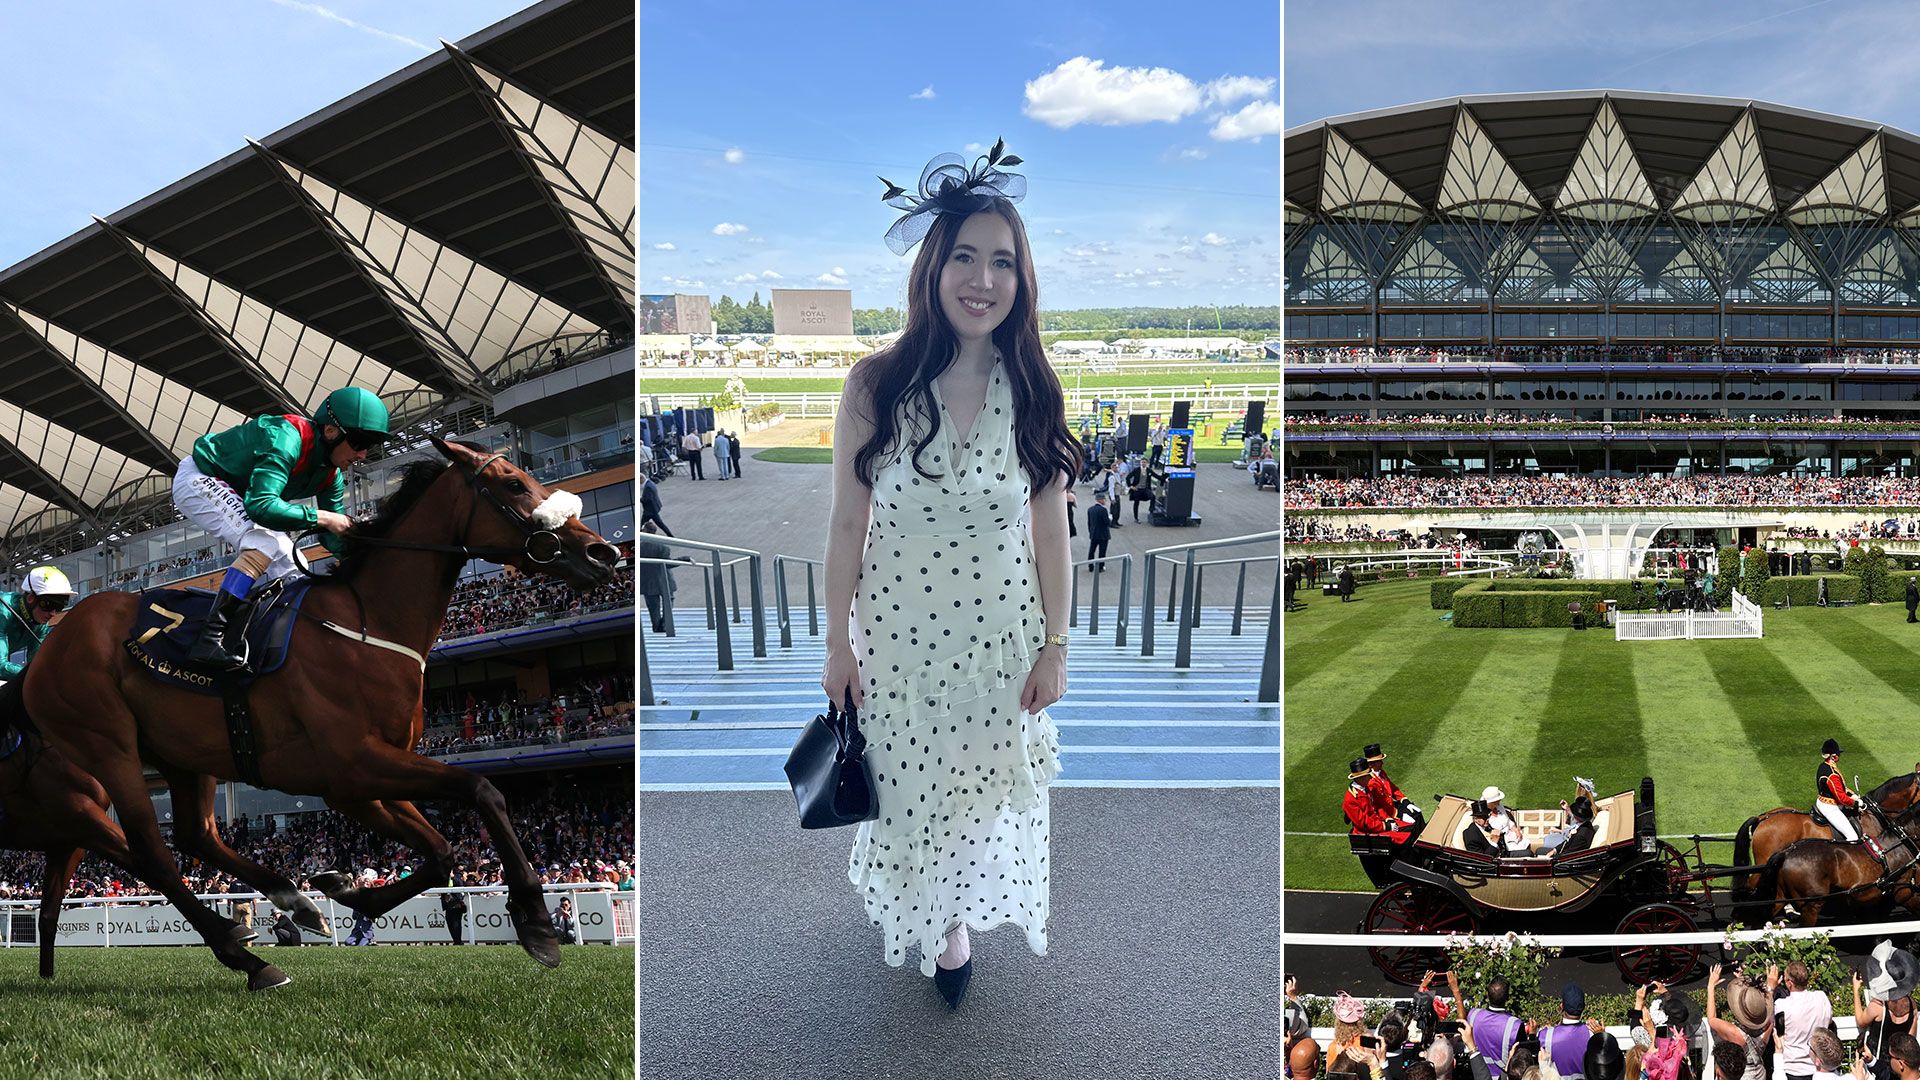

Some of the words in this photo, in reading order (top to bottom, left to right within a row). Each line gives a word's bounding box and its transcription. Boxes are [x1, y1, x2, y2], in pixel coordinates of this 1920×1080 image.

[138, 602, 185, 644] 7
[172, 669, 214, 687] ASCOT
[56, 922, 90, 932] NGINES
[162, 920, 193, 933] ASC
[376, 915, 424, 929] OYAL
